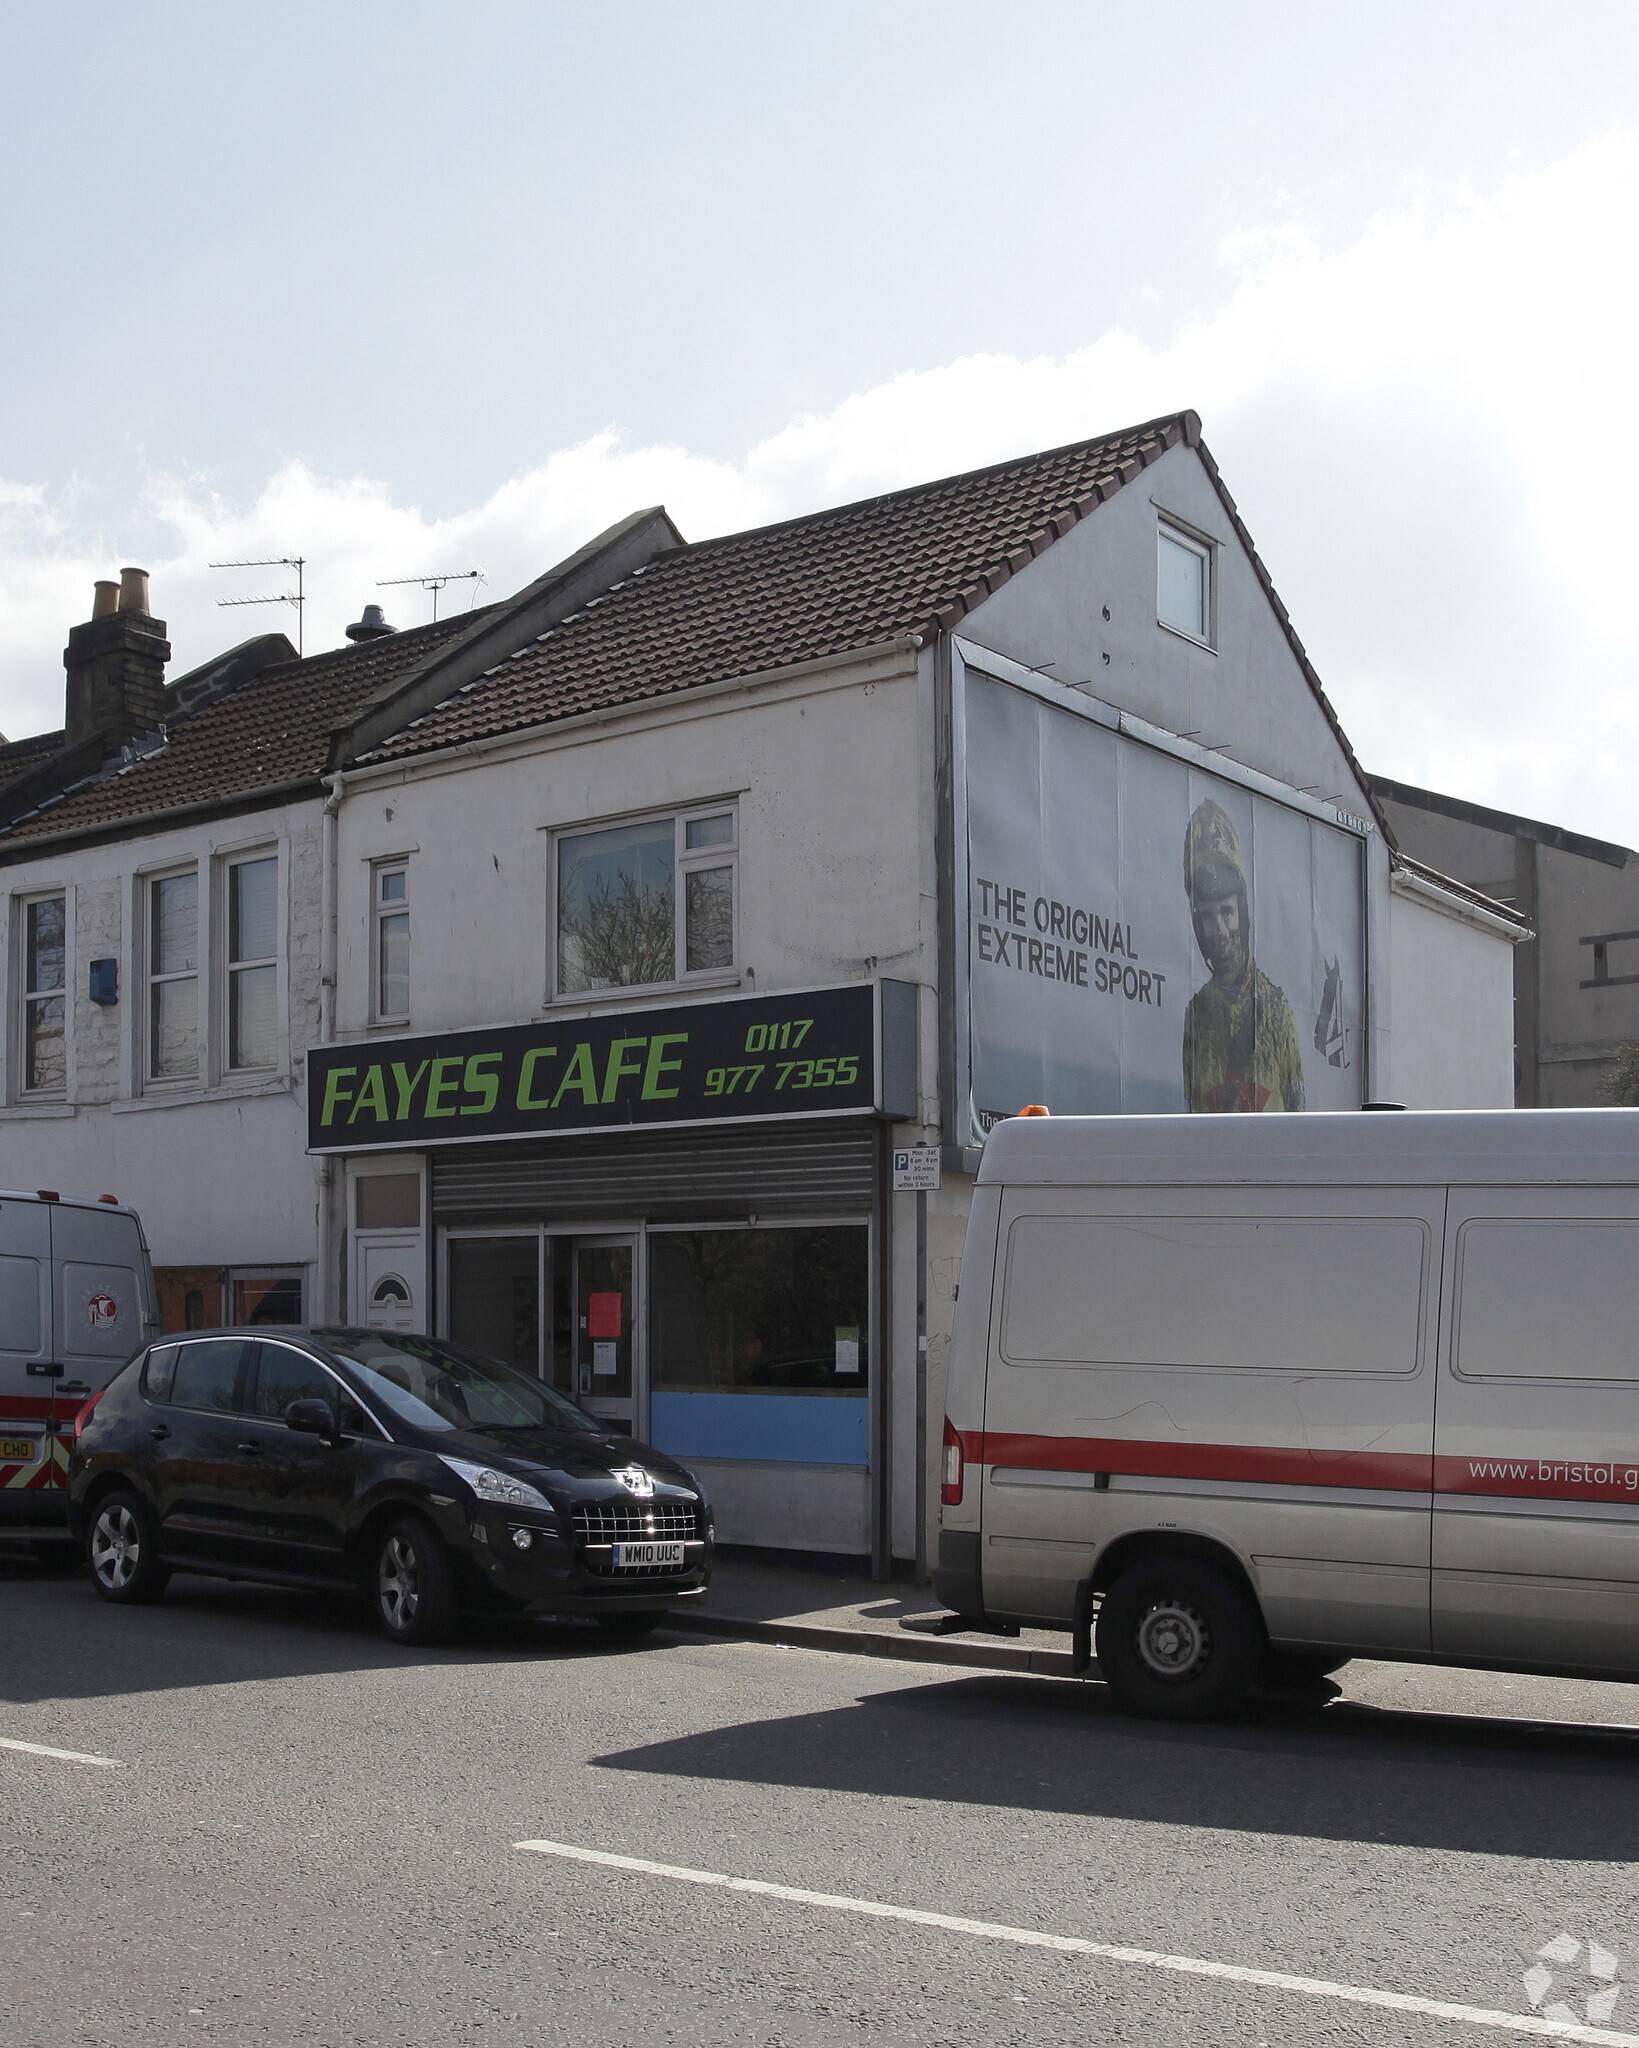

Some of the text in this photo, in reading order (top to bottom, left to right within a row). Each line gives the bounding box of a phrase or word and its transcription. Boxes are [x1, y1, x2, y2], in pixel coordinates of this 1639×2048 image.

[977, 877, 1138, 960] THE ORIGINAL
[977, 923, 1166, 1006] EXTREME SPORT
[744, 1019, 814, 1052] 0117
[320, 1033, 689, 1126] FAYES CAFE
[703, 1056, 860, 1096] 977 7355
[898, 1155, 907, 1169] P
[1469, 1460, 1638, 1490] www.bristol.g
[625, 1544, 680, 1562] WM10 UUC
